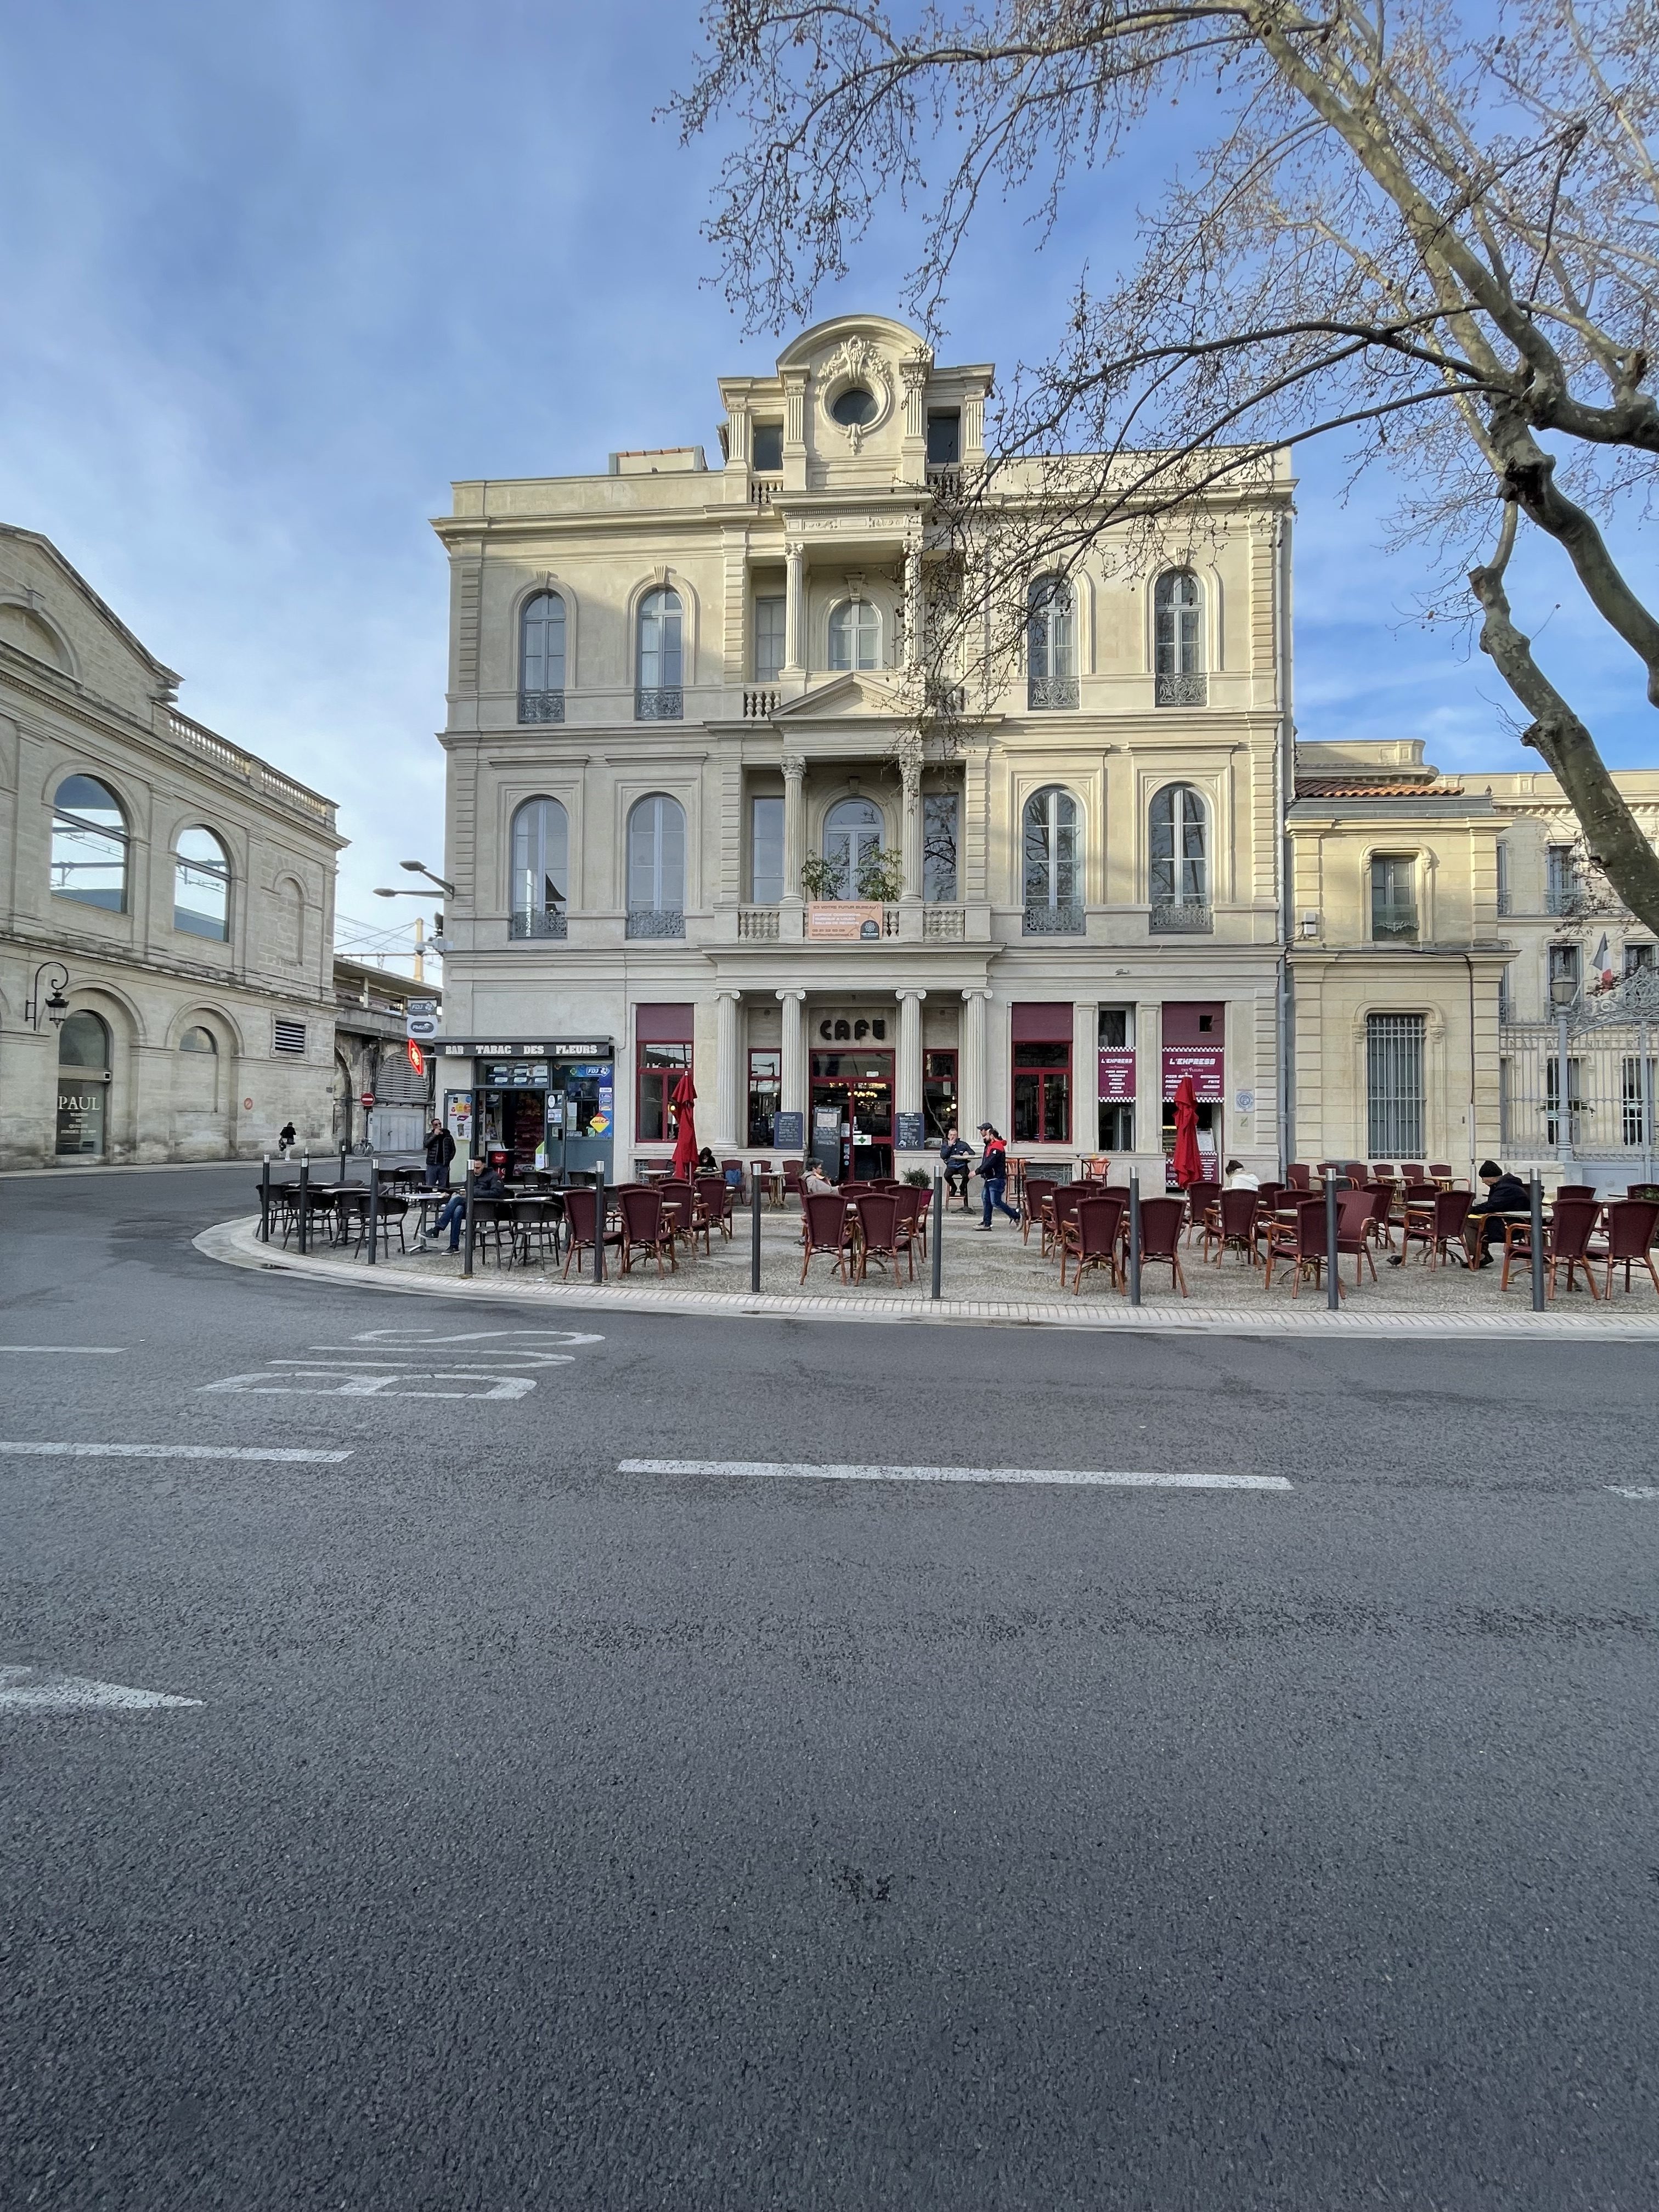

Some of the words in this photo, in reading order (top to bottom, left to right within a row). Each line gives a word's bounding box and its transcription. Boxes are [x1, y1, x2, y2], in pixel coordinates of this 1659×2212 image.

[820, 1019, 885, 1040] CAFE
[445, 1045, 464, 1055] BAR
[476, 1045, 512, 1054] TABAC
[523, 1045, 544, 1054] DES
[556, 1045, 598, 1054] FLEURS
[58, 1096, 101, 1111] PAUL
